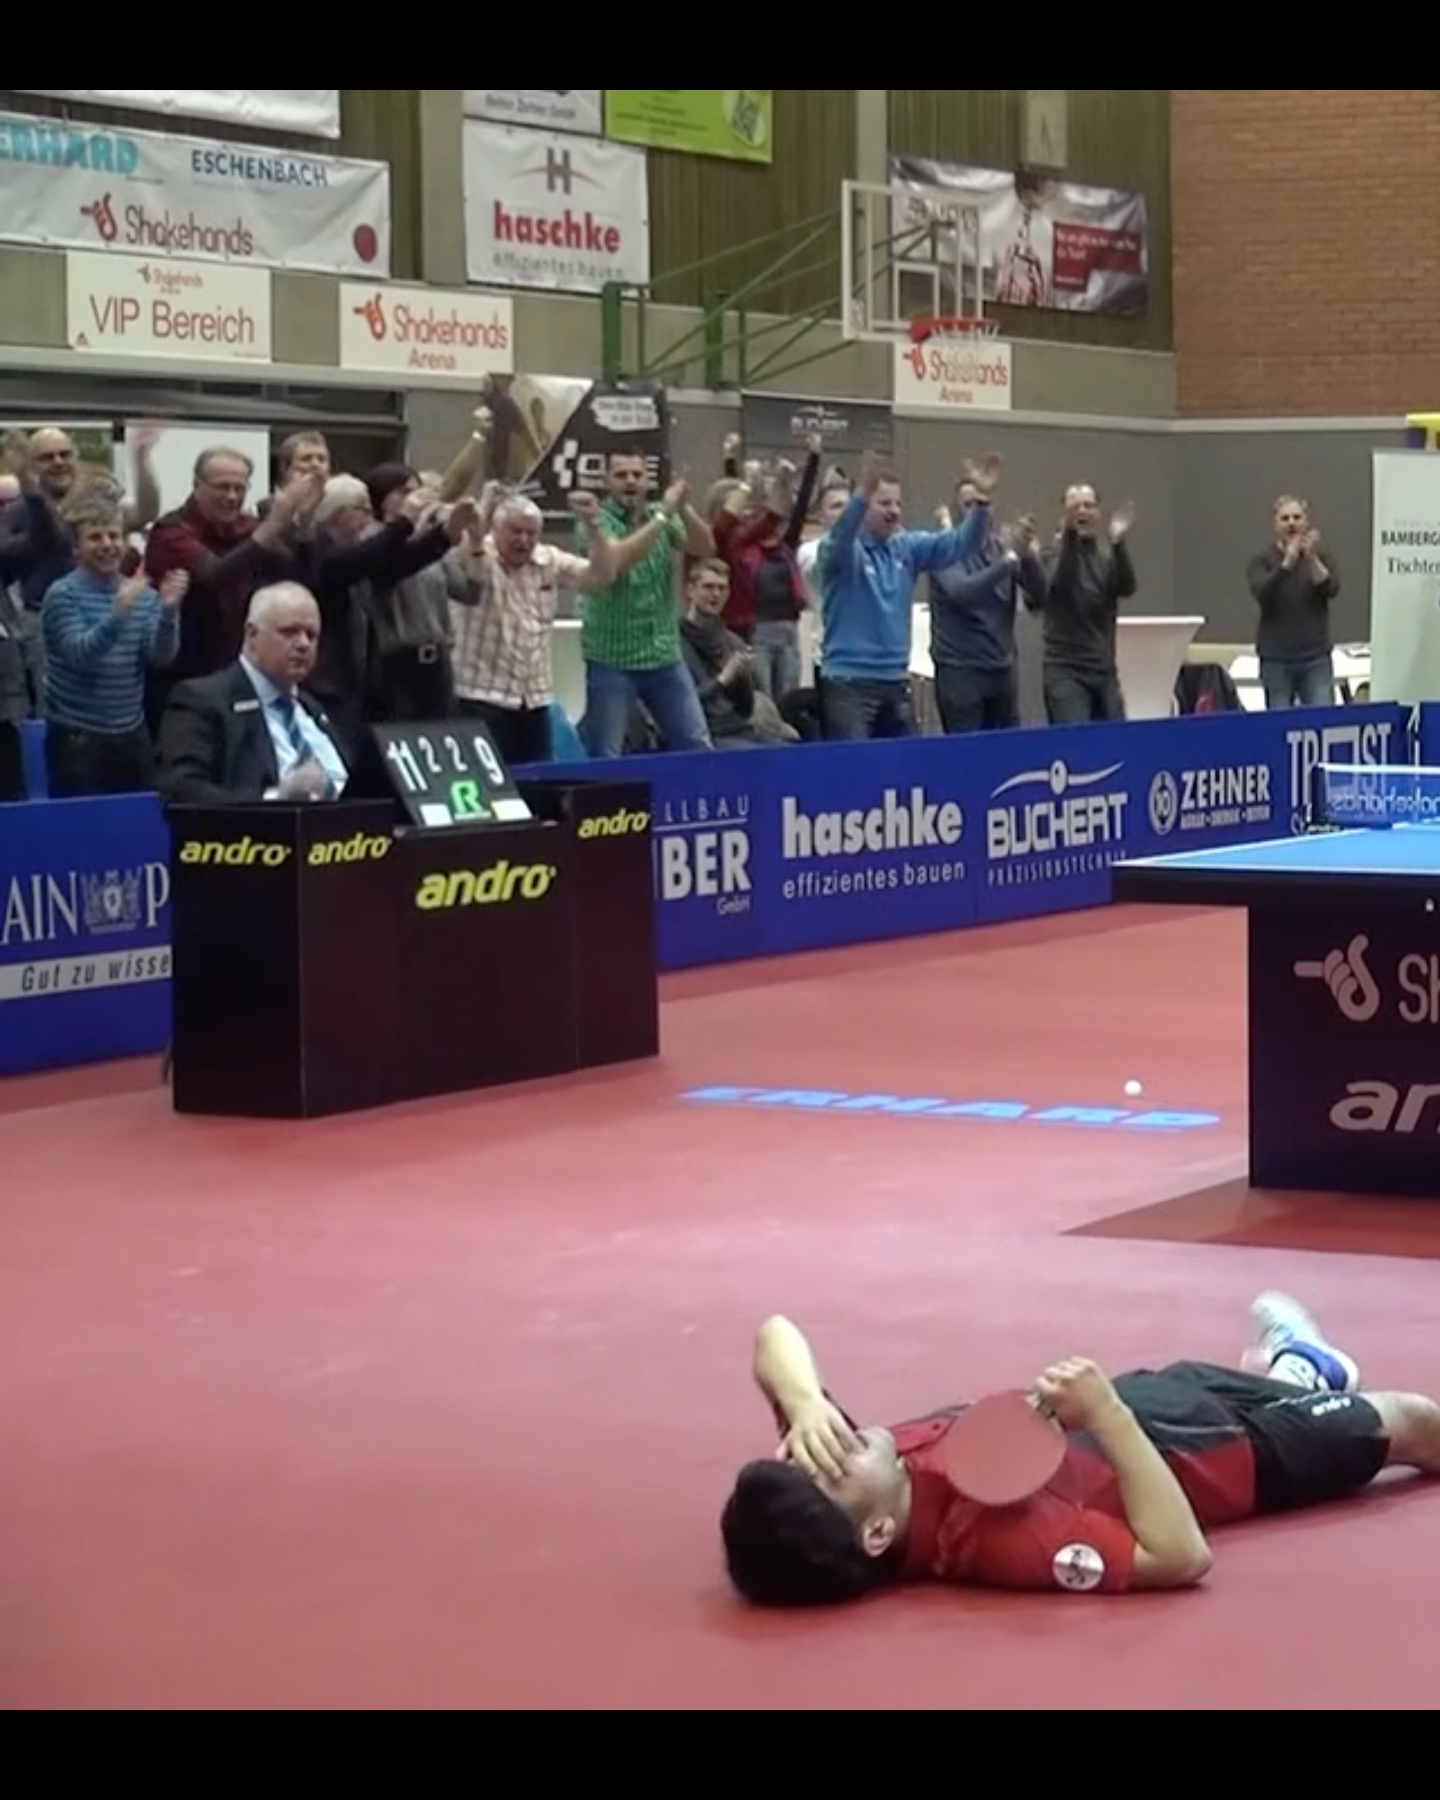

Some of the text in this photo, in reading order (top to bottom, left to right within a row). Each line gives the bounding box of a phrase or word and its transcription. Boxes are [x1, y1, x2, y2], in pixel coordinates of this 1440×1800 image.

[191, 149, 329, 187] ESCHENBACH
[125, 203, 254, 256] Shakehands
[494, 199, 620, 254] haschke
[89, 293, 255, 344] VIP Bereich
[393, 302, 508, 349] Shakehands
[408, 348, 457, 370] Arena
[418, 735, 442, 773] 2
[444, 735, 468, 772] 2
[473, 735, 505, 786] 9
[663, 795, 748, 823] LLBAU
[1180, 764, 1271, 811] ZEHNER
[577, 807, 649, 839] andro
[782, 786, 963, 859] haschke
[987, 791, 1128, 860] BUCHERT
[178, 835, 288, 867] andro
[307, 831, 391, 866] andro
[652, 829, 751, 901] BER
[415, 860, 553, 910] andro
[782, 860, 965, 900] effizientes bauen
[0, 872, 78, 945] AIN
[716, 896, 750, 916] GmbH
[21, 953, 170, 993] Gut zu wisse
[676, 1085, 1221, 1131] ERHARD
